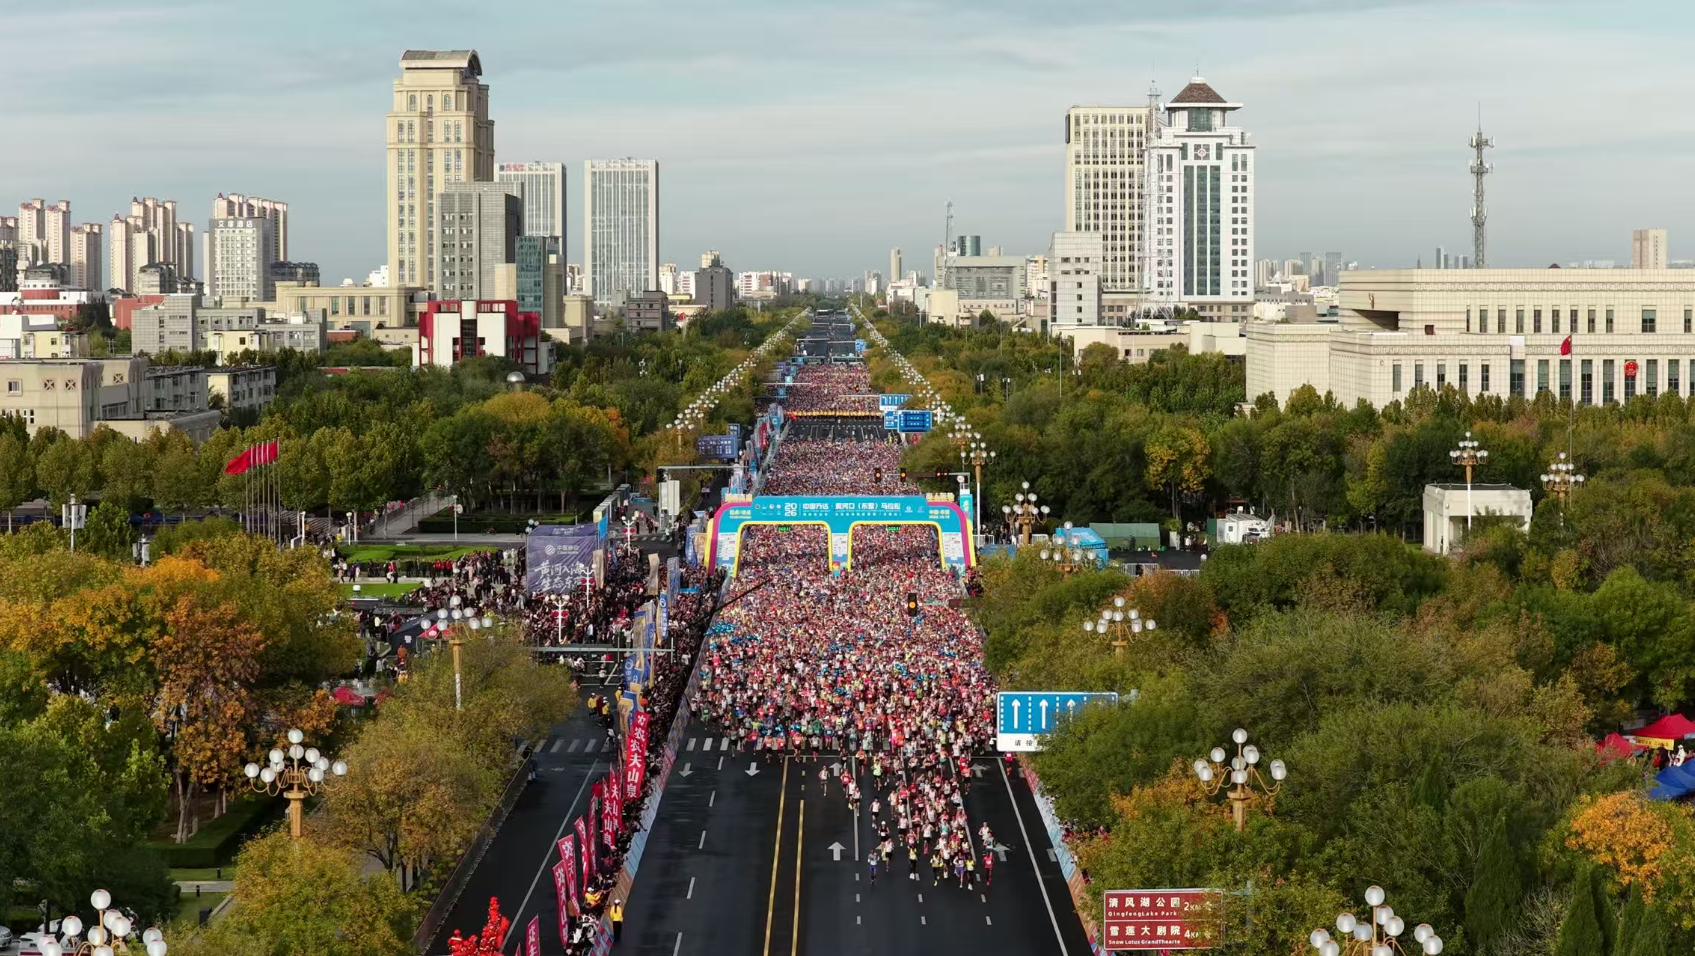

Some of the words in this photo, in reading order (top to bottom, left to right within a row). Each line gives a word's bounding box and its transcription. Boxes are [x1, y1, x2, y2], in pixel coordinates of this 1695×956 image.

[784, 509, 798, 517] 26
[626, 739, 643, 798] 农夫山泉
[1108, 897, 1181, 908] 清风湖公园
